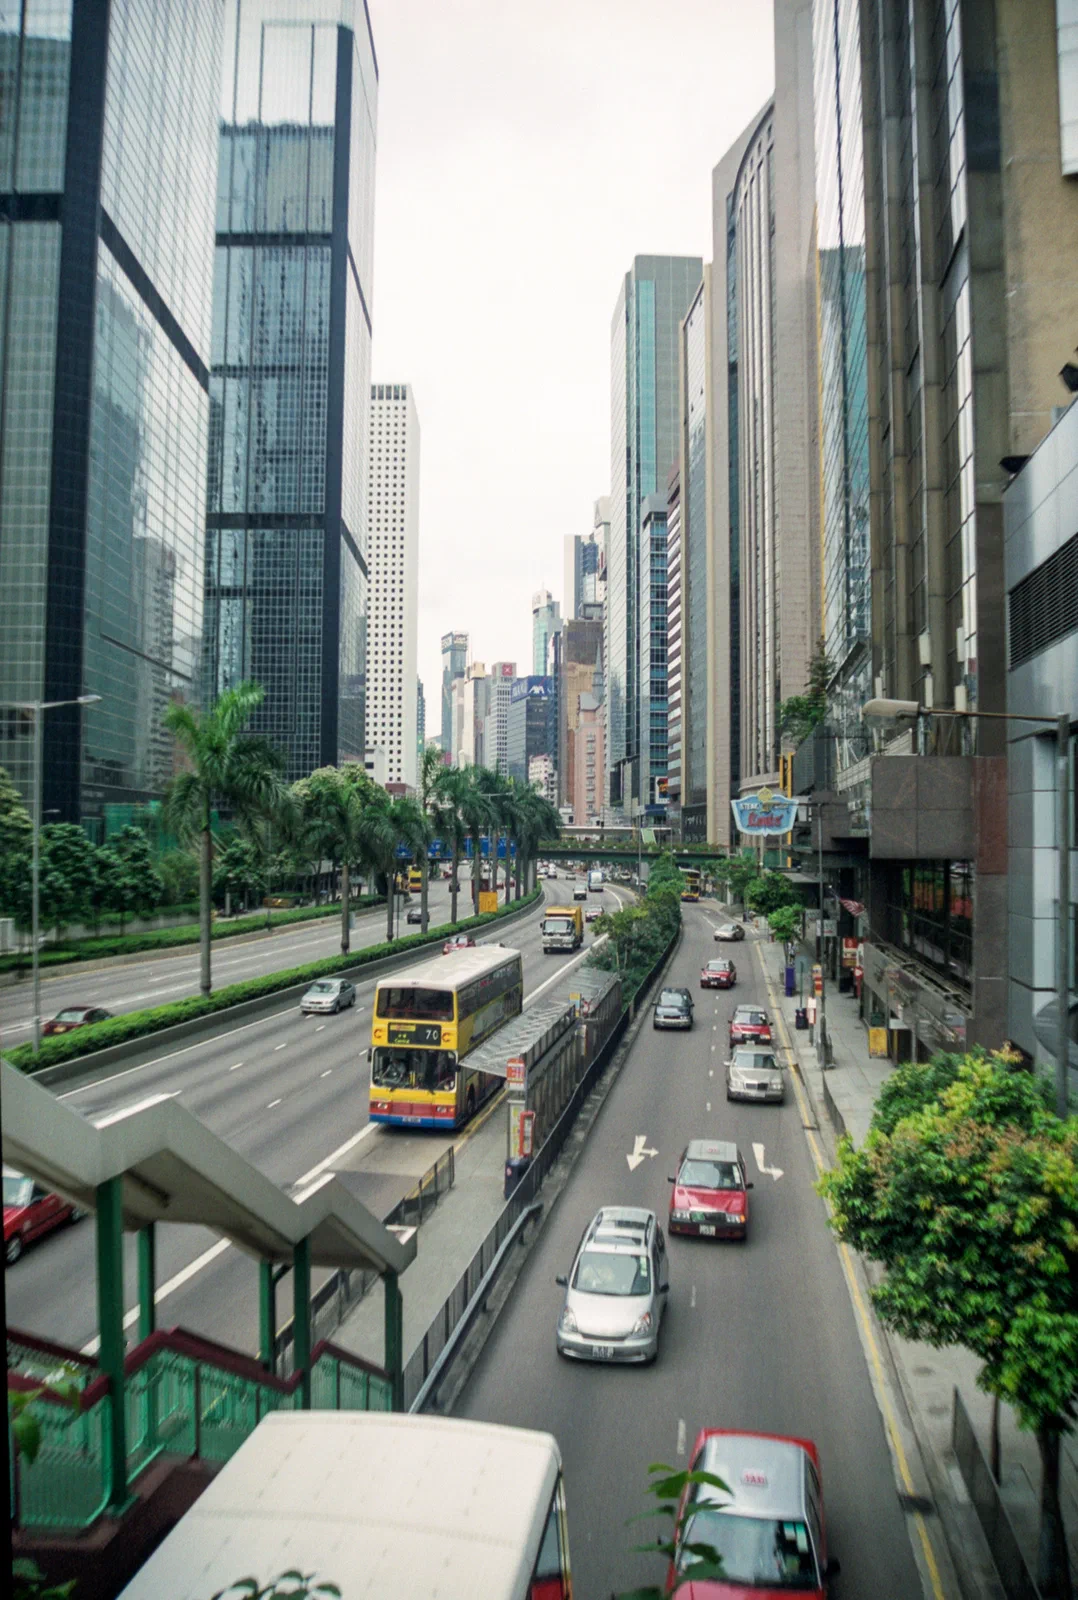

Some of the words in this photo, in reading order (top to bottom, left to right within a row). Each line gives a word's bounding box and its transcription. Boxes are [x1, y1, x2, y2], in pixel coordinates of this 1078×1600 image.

[528, 685, 545, 694] AXA
[425, 1029, 439, 1041] 70
[745, 1474, 765, 1483] TAXI
